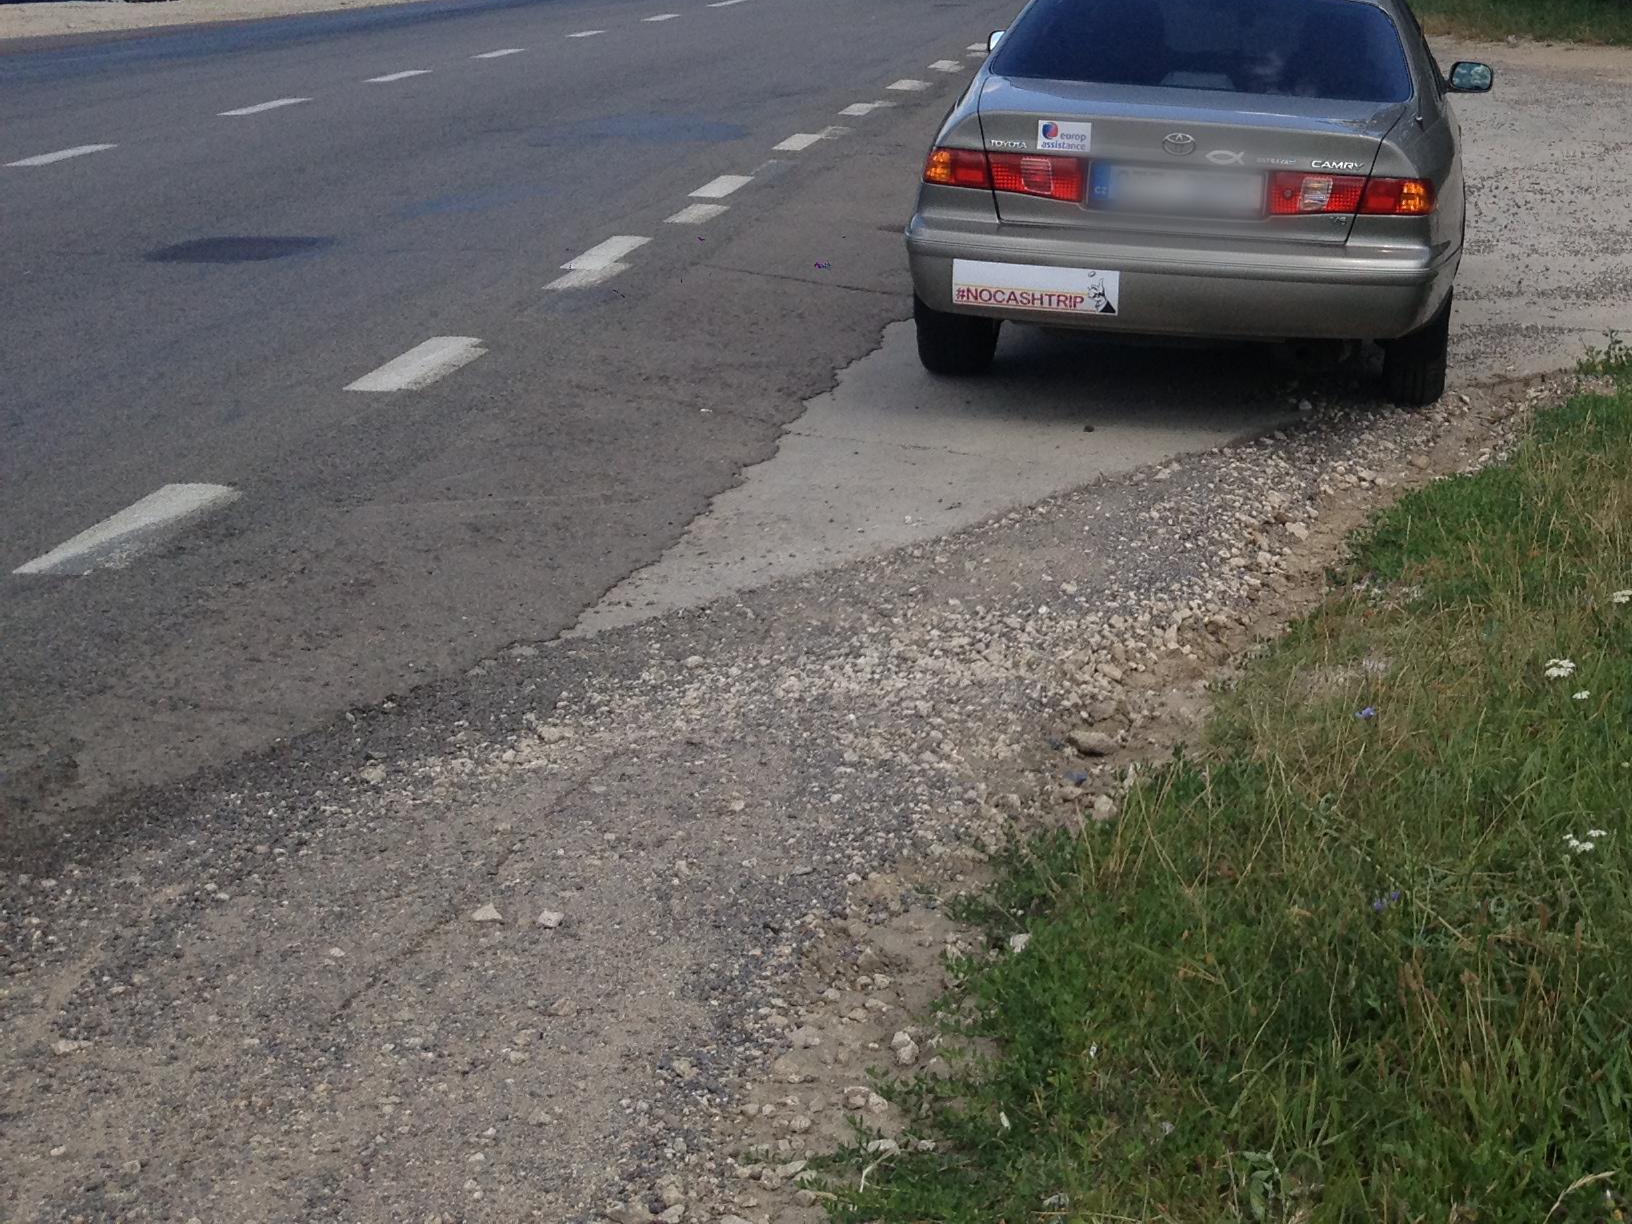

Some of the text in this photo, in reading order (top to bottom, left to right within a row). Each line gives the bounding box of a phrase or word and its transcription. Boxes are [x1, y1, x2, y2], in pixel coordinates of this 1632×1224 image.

[1060, 132, 1087, 142] europ
[990, 139, 1027, 149] TOYOTA
[1041, 140, 1086, 151] assistance
[1311, 160, 1364, 169] CAMRY
[955, 287, 1084, 309] #NOCASHTRIP
